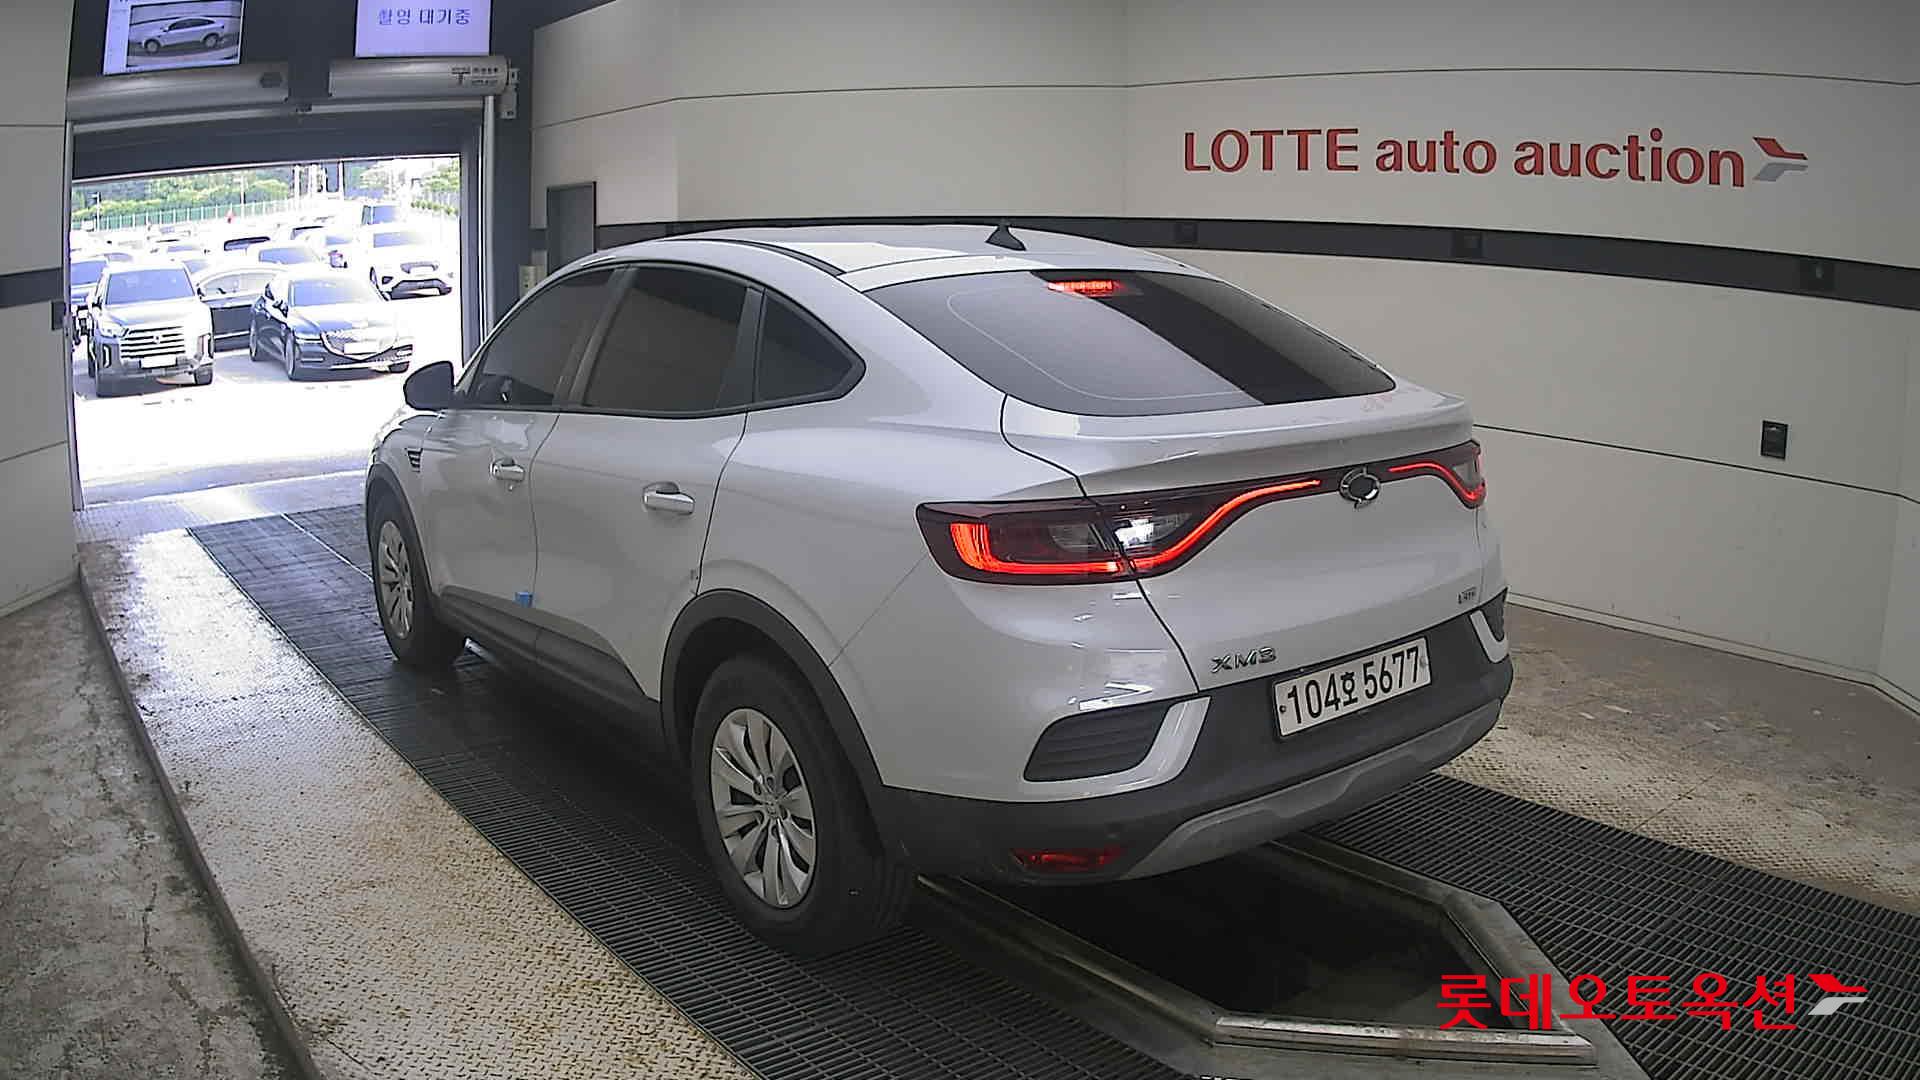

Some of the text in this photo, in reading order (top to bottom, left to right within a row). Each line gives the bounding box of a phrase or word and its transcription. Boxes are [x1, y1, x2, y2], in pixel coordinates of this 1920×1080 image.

[1184, 127, 1745, 188] LOTTE auto auction
[1210, 646, 1277, 674] XM3
[1287, 645, 1420, 724] 104호 5677
